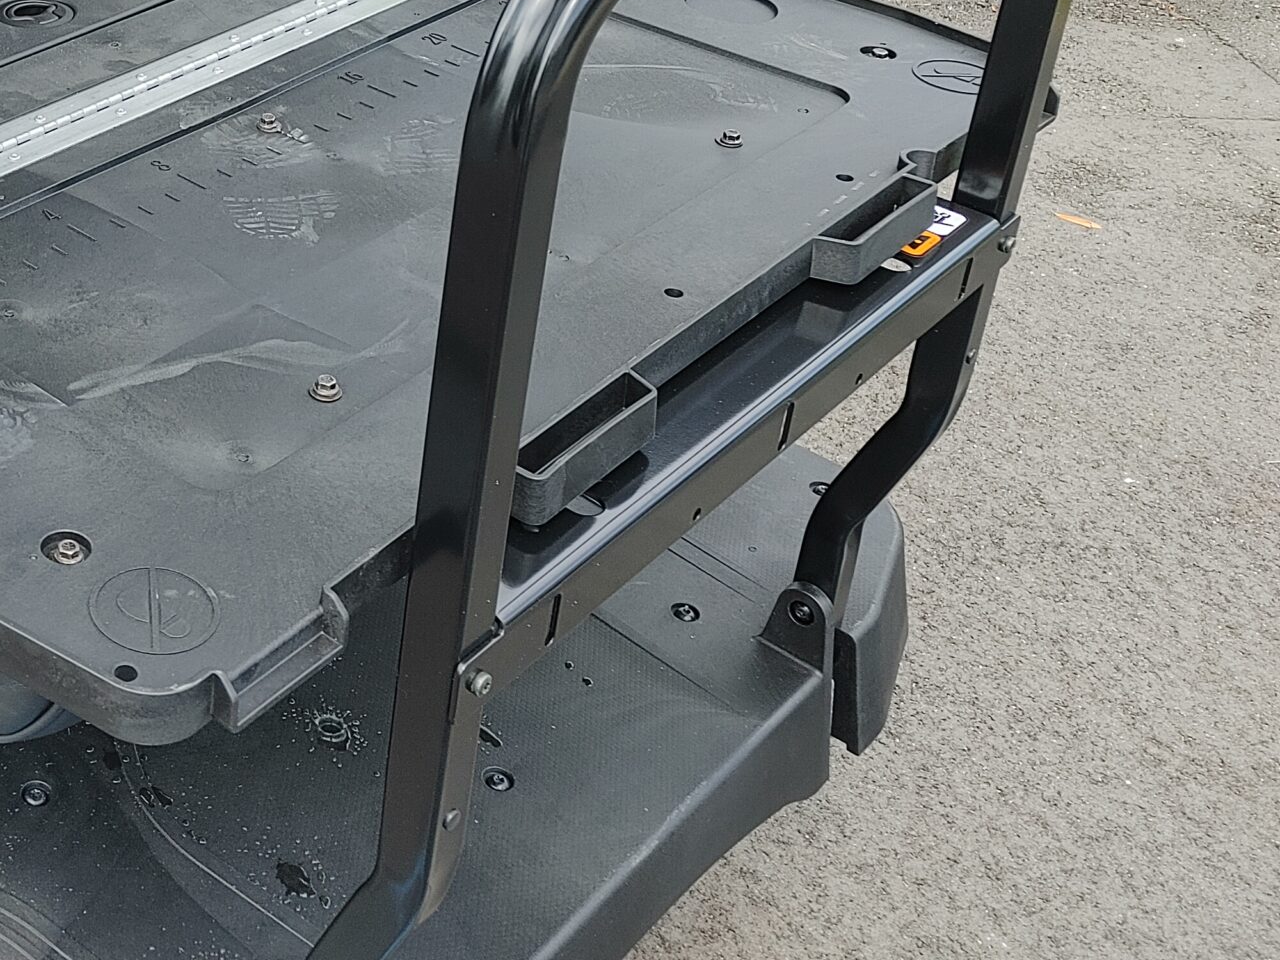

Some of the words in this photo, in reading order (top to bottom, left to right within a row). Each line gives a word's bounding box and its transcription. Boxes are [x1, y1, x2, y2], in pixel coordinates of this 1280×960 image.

[42, 208, 62, 221] 4
[150, 160, 171, 171] 8
[337, 71, 364, 85] 16
[421, 32, 448, 46] 20
